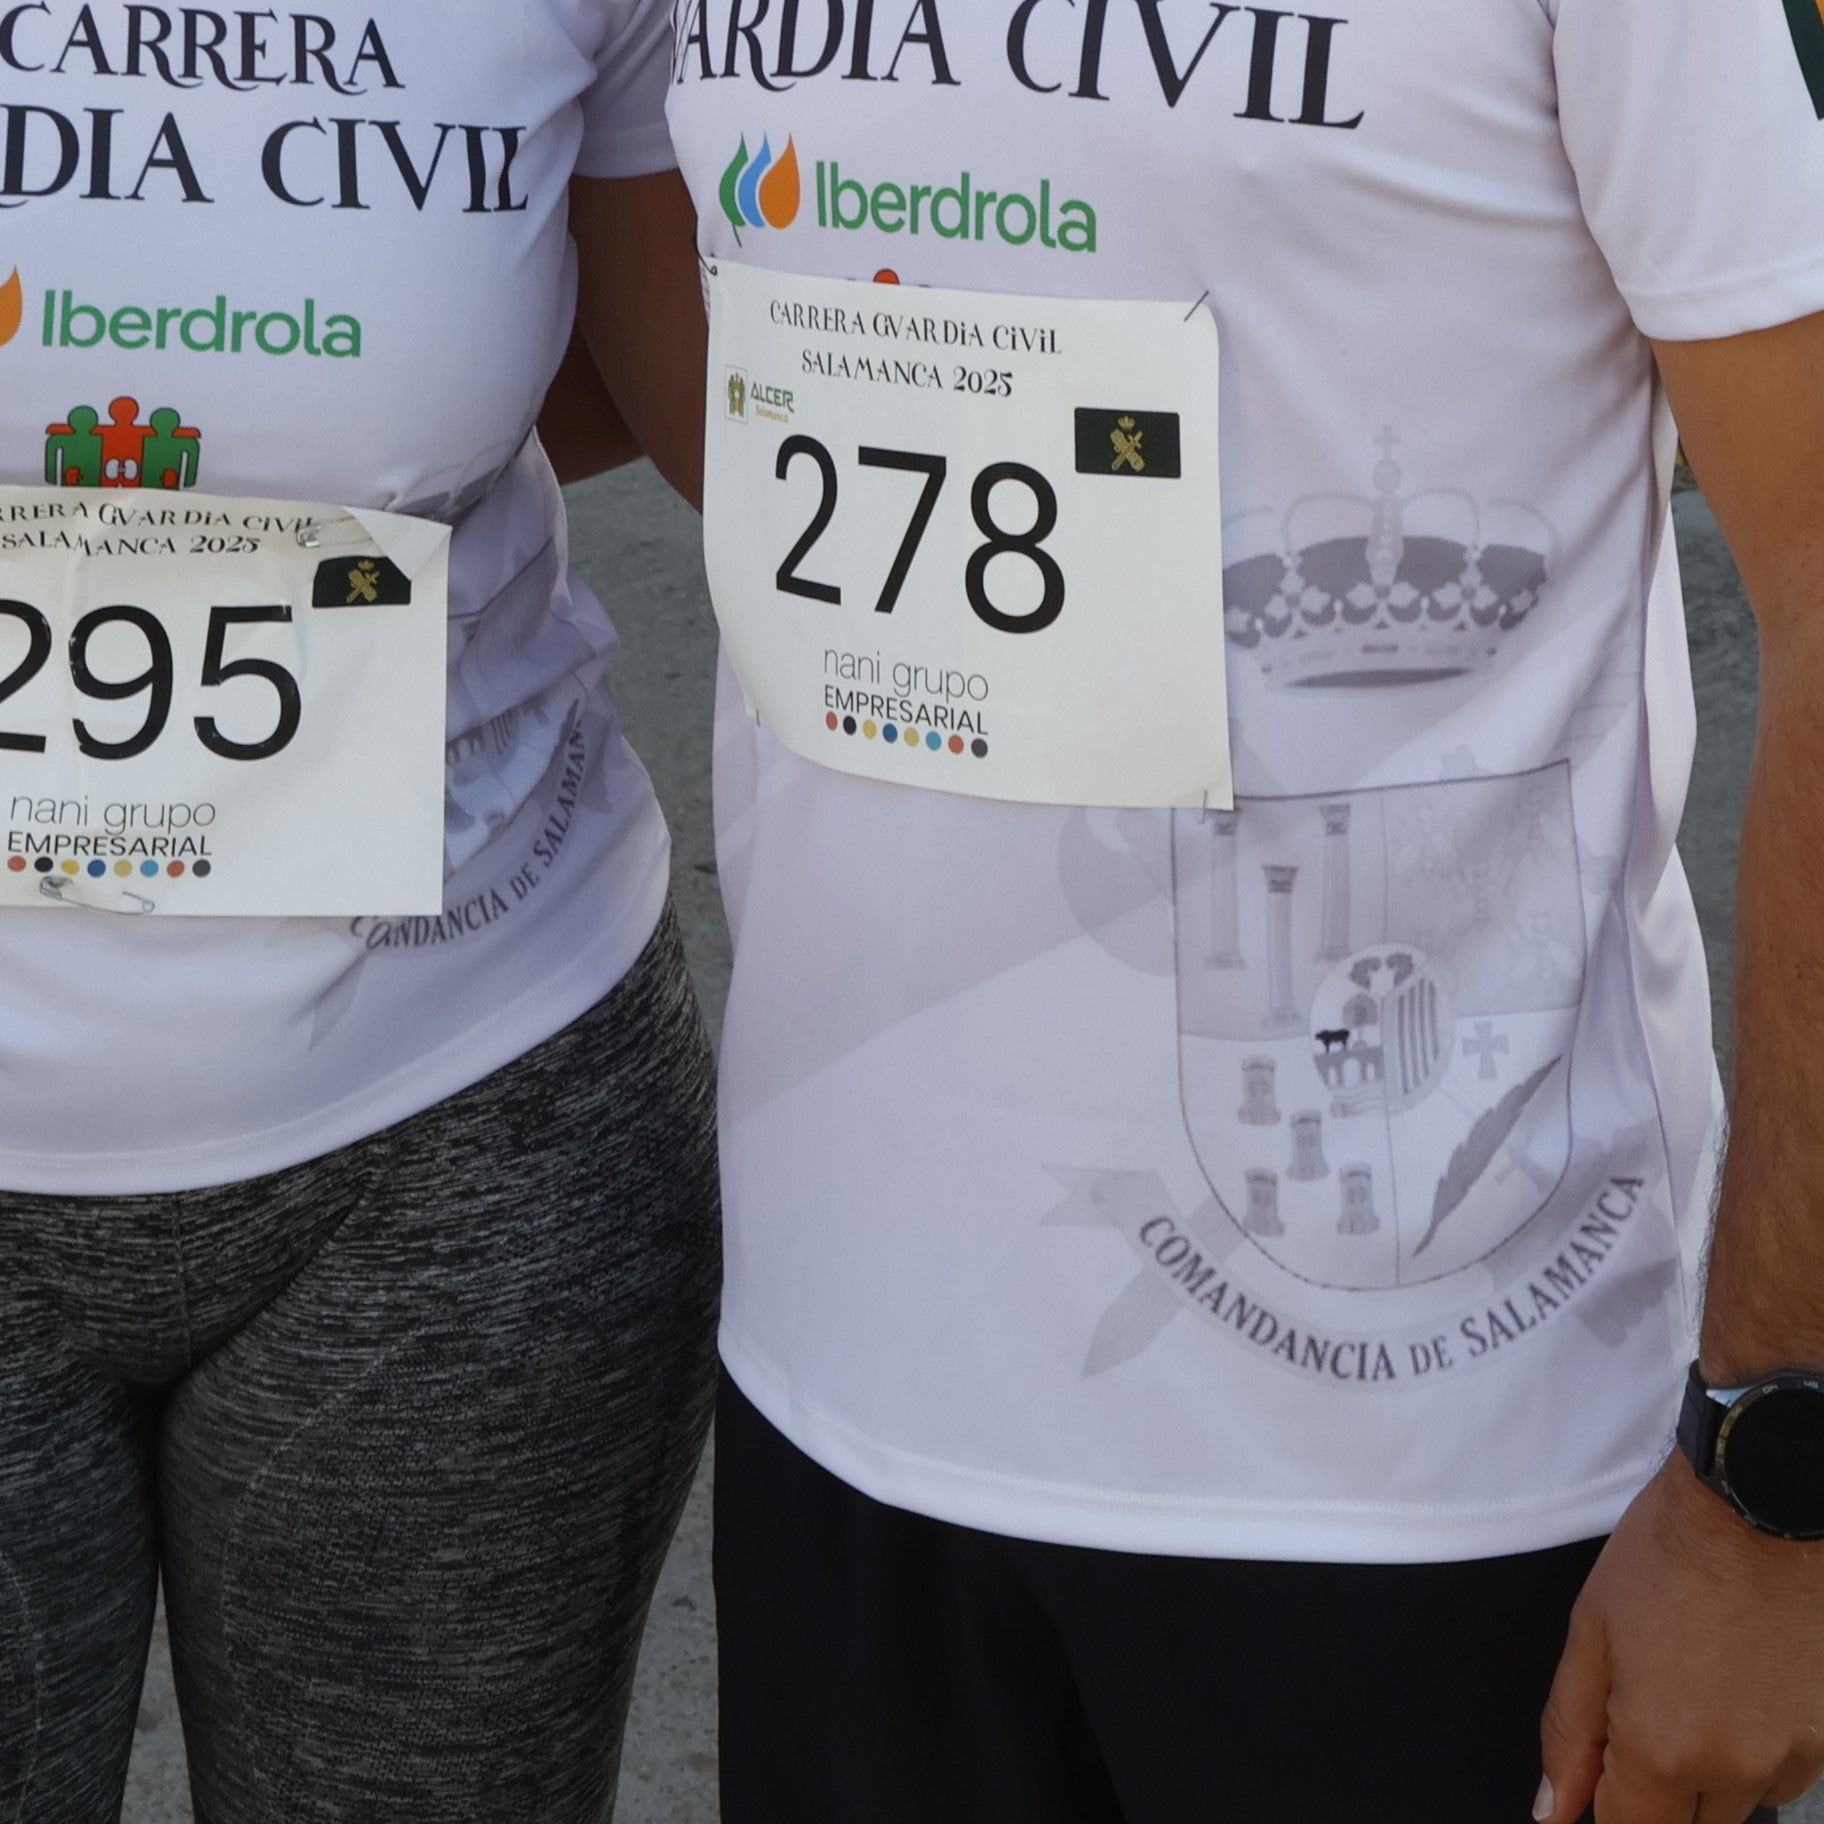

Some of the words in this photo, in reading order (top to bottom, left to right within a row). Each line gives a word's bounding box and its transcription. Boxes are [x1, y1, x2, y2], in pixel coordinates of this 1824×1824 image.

[261, 117, 528, 213] CIVIL
[816, 161, 1096, 253] Iberdrola
[42, 288, 361, 359] Iberdrola
[770, 299, 865, 336] CARRERA
[750, 381, 794, 413] ALCER
[802, 348, 943, 388] SALAMANCA
[953, 365, 1013, 397] 2025
[2, 530, 176, 557] SALAMANCA
[189, 535, 261, 555] 2025
[776, 433, 1065, 634] 278
[825, 648, 880, 685] nani
[892, 662, 988, 704] grupo
[825, 683, 989, 735] EMPRESARIAL
[10, 795, 89, 826] nani
[104, 803, 216, 836] grupo
[7, 831, 213, 857] EMPRESARIAL
[510, 862, 540, 901] DE
[1139, 1215, 1396, 1381] COMANDANCIA
[1410, 1336, 1453, 1375] DE
[1460, 1175, 1644, 1358] SALAMANCA
